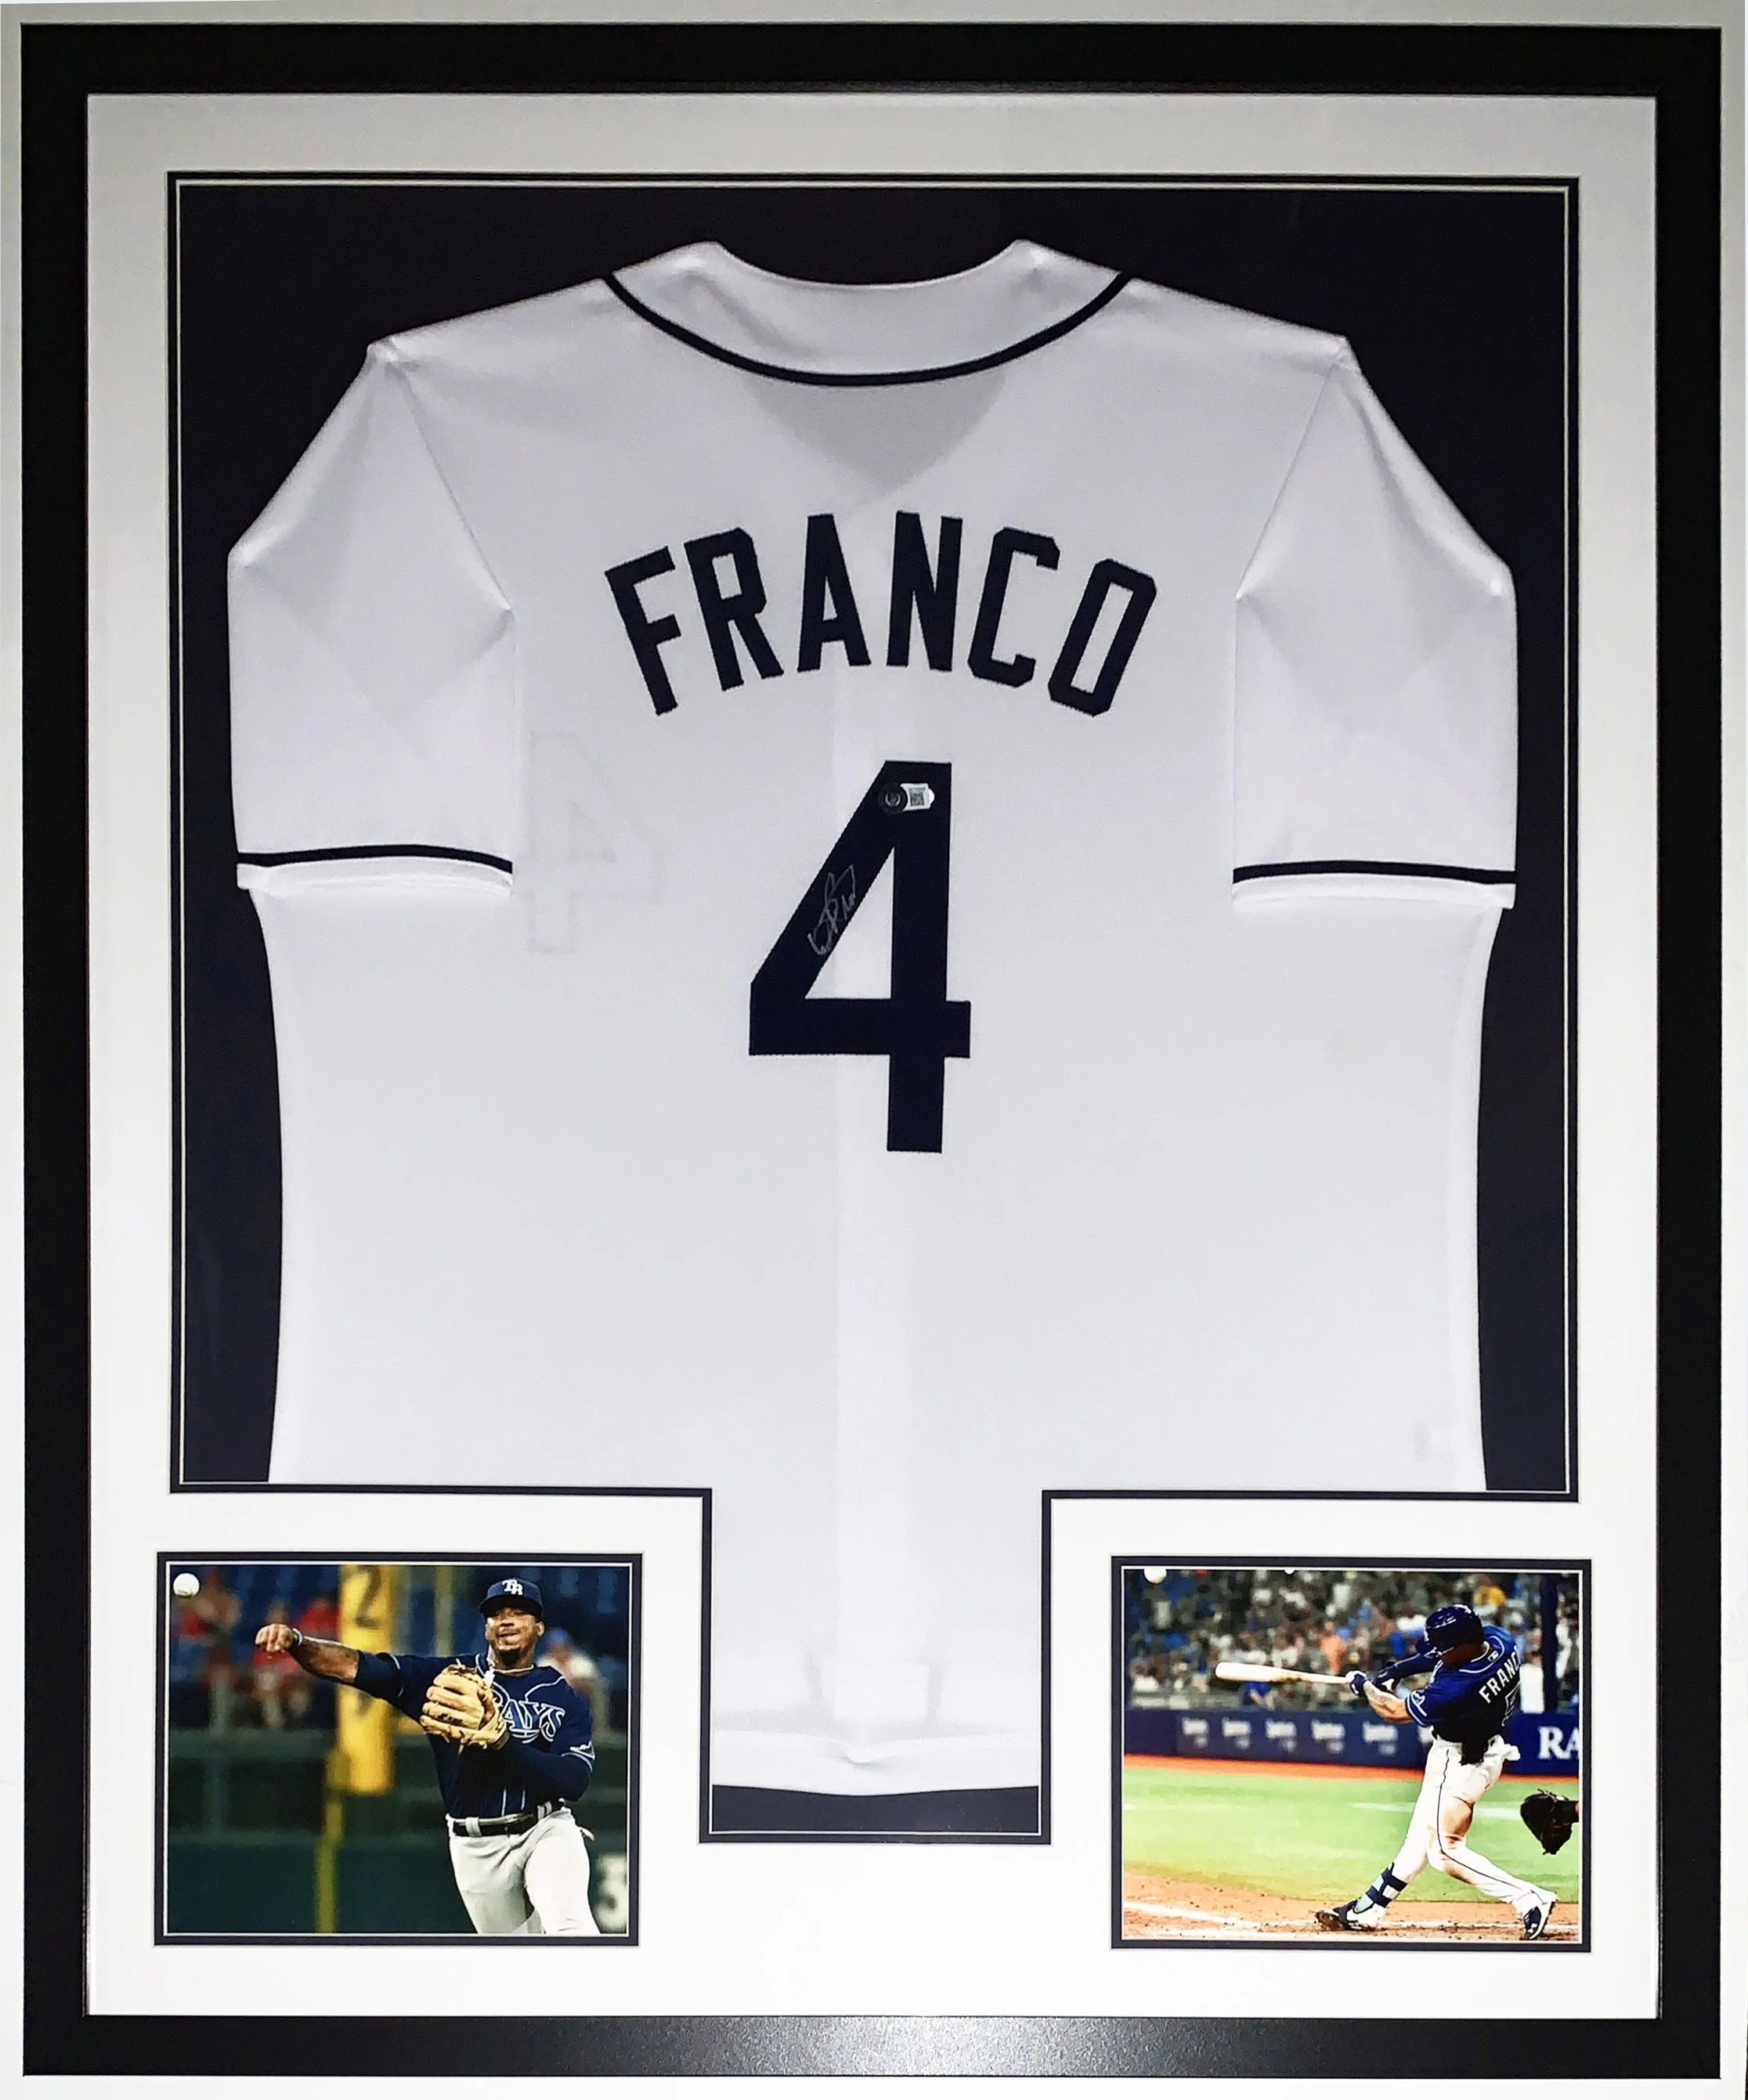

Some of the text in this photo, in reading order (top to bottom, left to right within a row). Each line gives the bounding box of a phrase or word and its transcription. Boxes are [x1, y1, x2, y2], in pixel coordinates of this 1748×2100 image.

[605, 511, 1157, 717] FRANCO
[749, 760, 970, 1153] 4
[502, 1579, 523, 1595] TR
[1479, 1645, 1521, 1704] FRANC
